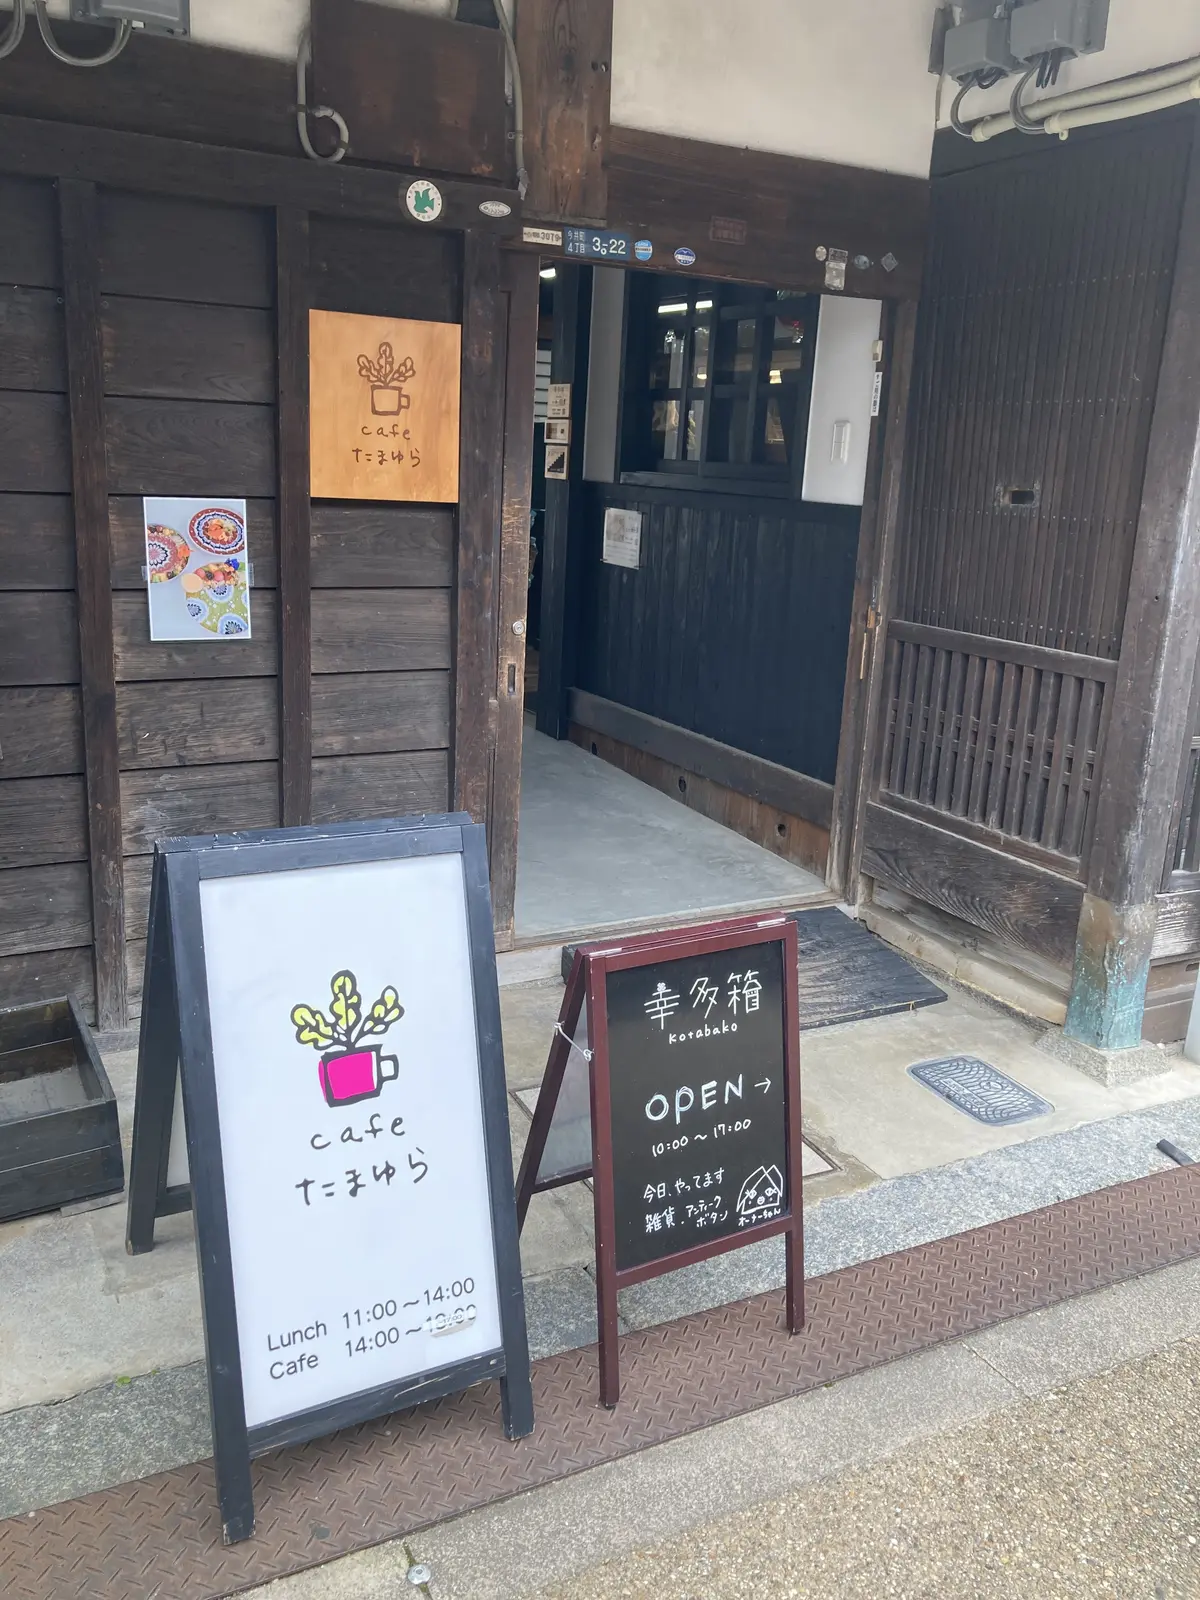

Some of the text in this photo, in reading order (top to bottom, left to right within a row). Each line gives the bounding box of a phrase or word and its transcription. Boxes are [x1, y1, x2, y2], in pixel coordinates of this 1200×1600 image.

[361, 424, 411, 440] cafe
[351, 448, 421, 467] たまゆら
[643, 969, 763, 1030] 幸多箱
[645, 1073, 744, 1125] OPEN
[310, 1112, 406, 1150] cafe
[295, 1146, 429, 1206] たまゆら
[267, 1320, 328, 1351] Lunch
[269, 1353, 319, 1380] Cafe
